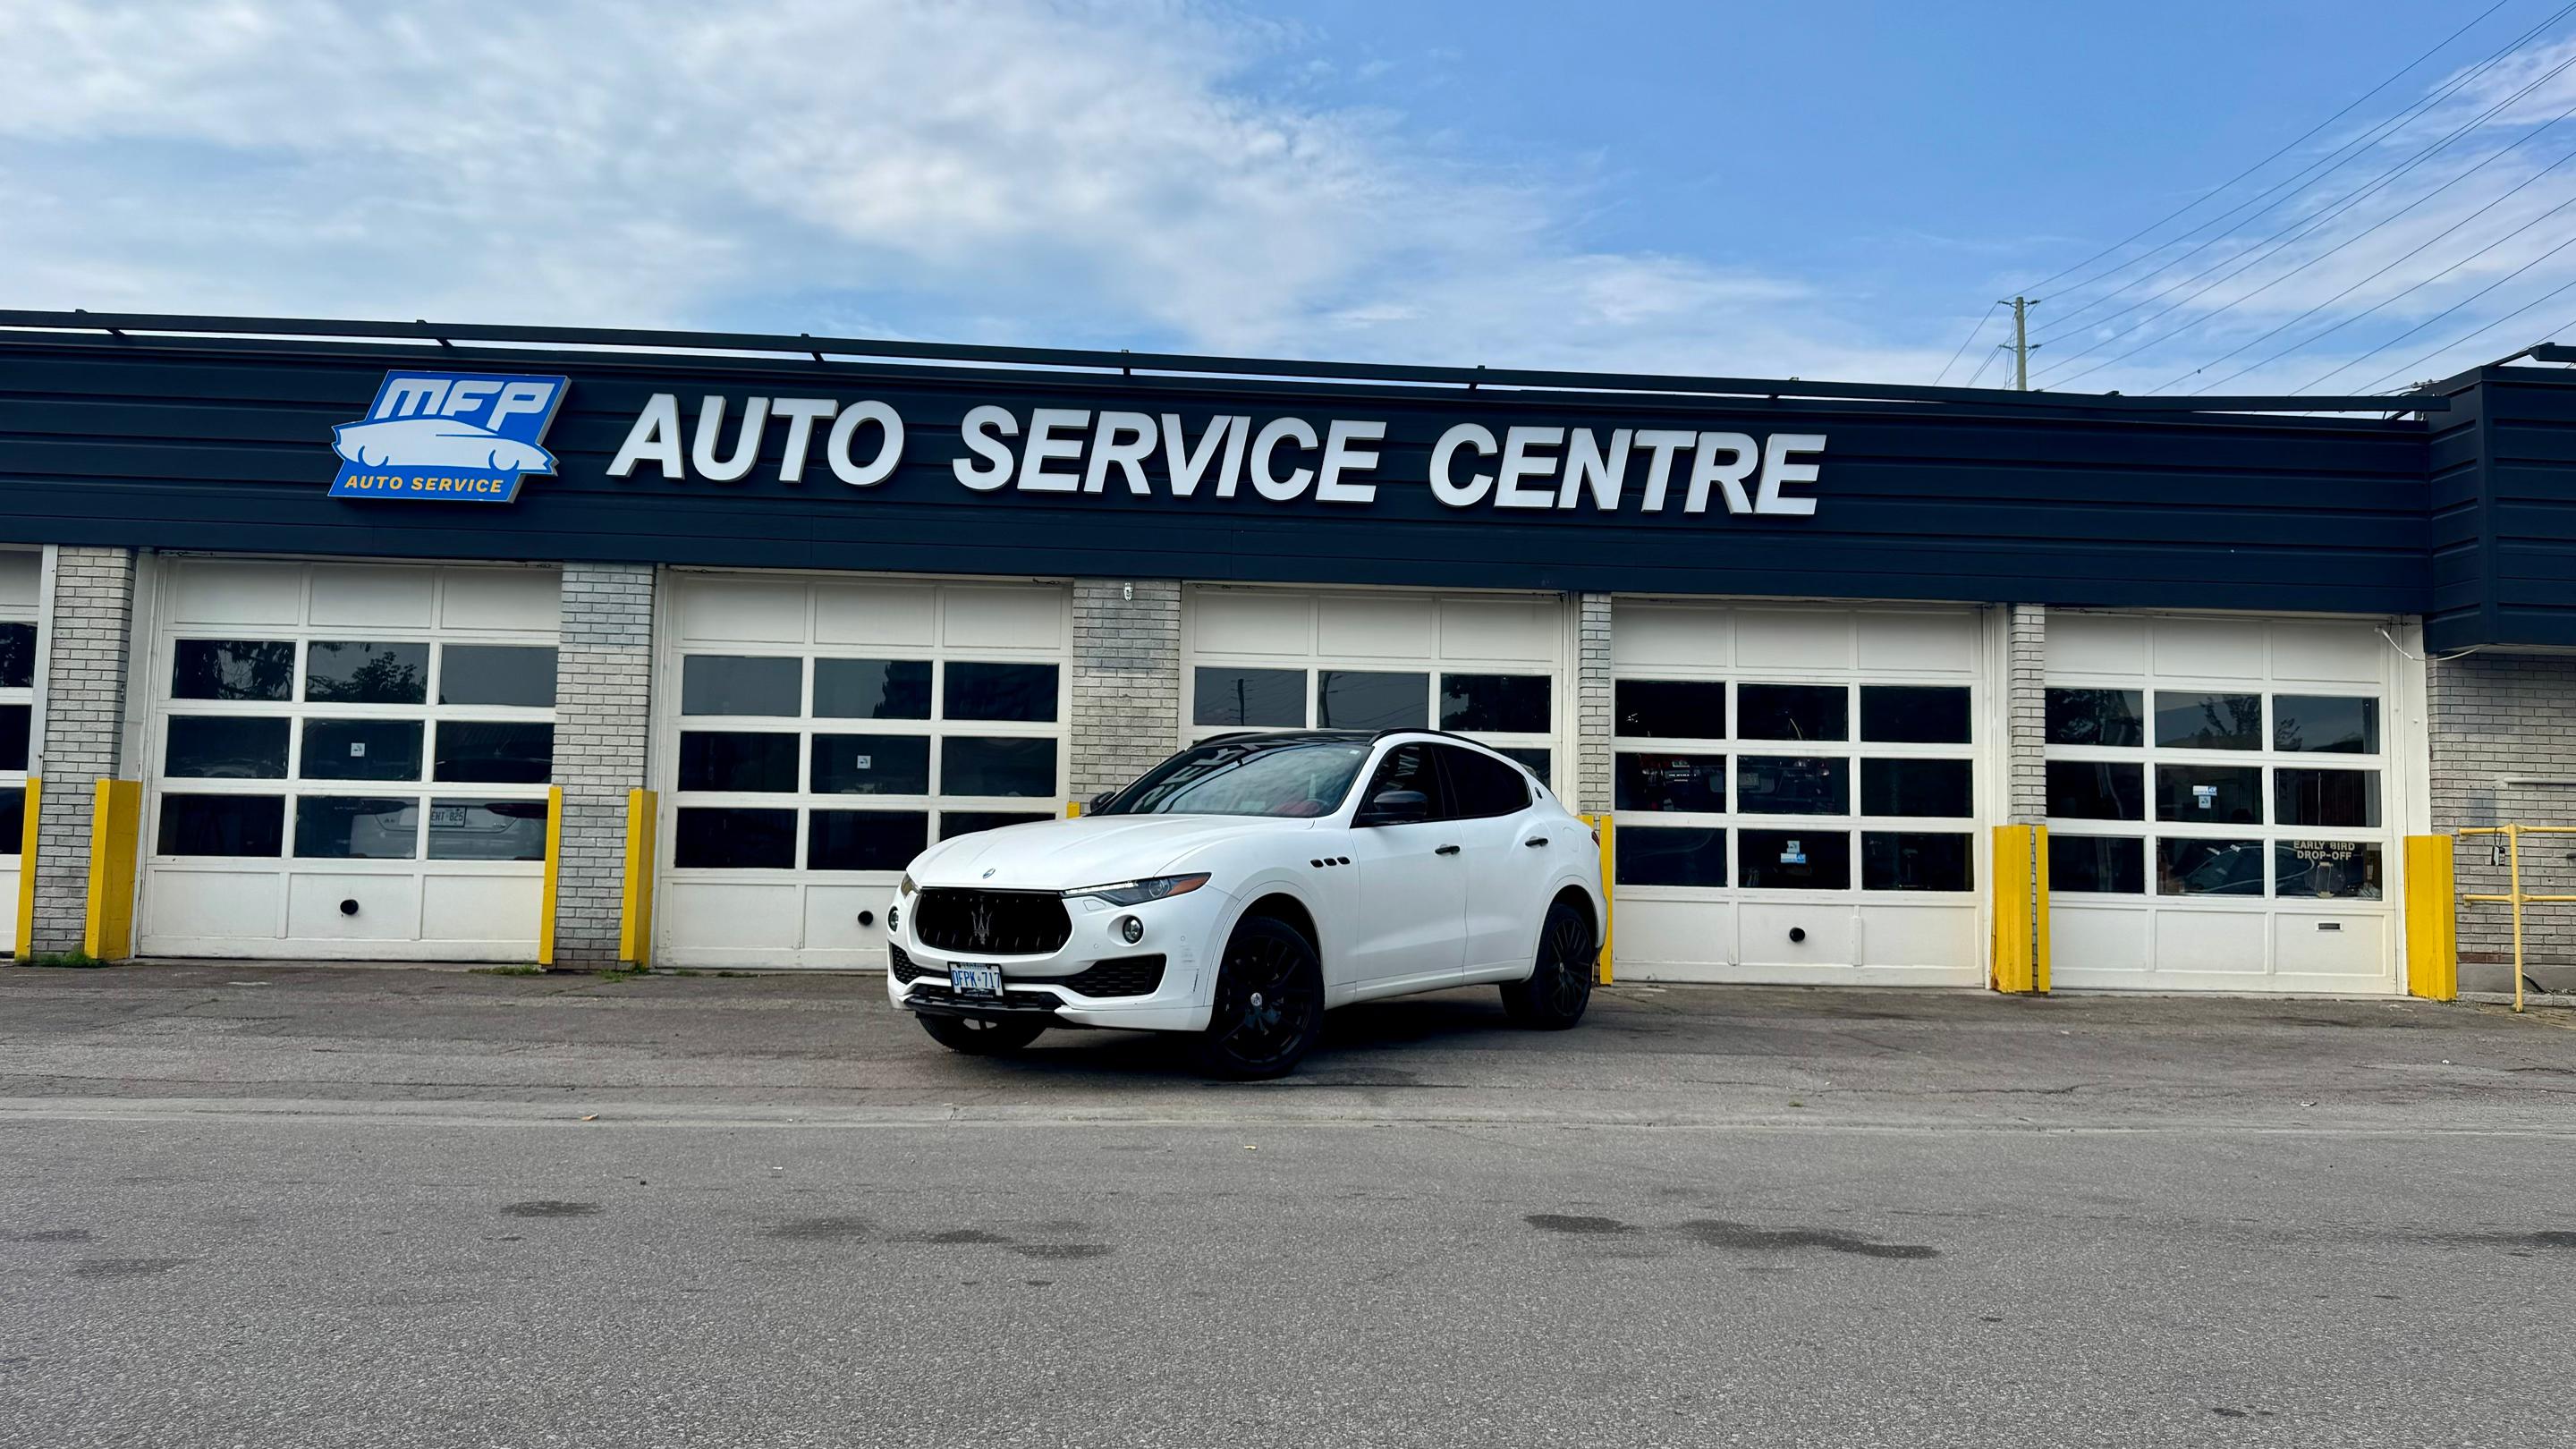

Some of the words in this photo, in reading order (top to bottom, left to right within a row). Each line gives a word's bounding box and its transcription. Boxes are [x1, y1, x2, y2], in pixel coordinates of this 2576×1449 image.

[374, 378, 555, 432] MFP
[606, 393, 904, 487] AUTO
[952, 404, 1387, 503] SERVICE
[1429, 422, 1827, 516] CENTRE
[344, 475, 403, 489] AUTO
[411, 477, 504, 493] SERVICE
[2293, 841, 2326, 851] EARLY
[2329, 842, 2355, 852] BIRD
[2296, 850, 2352, 861] DROP-OFF
[981, 971, 1001, 988] 717
